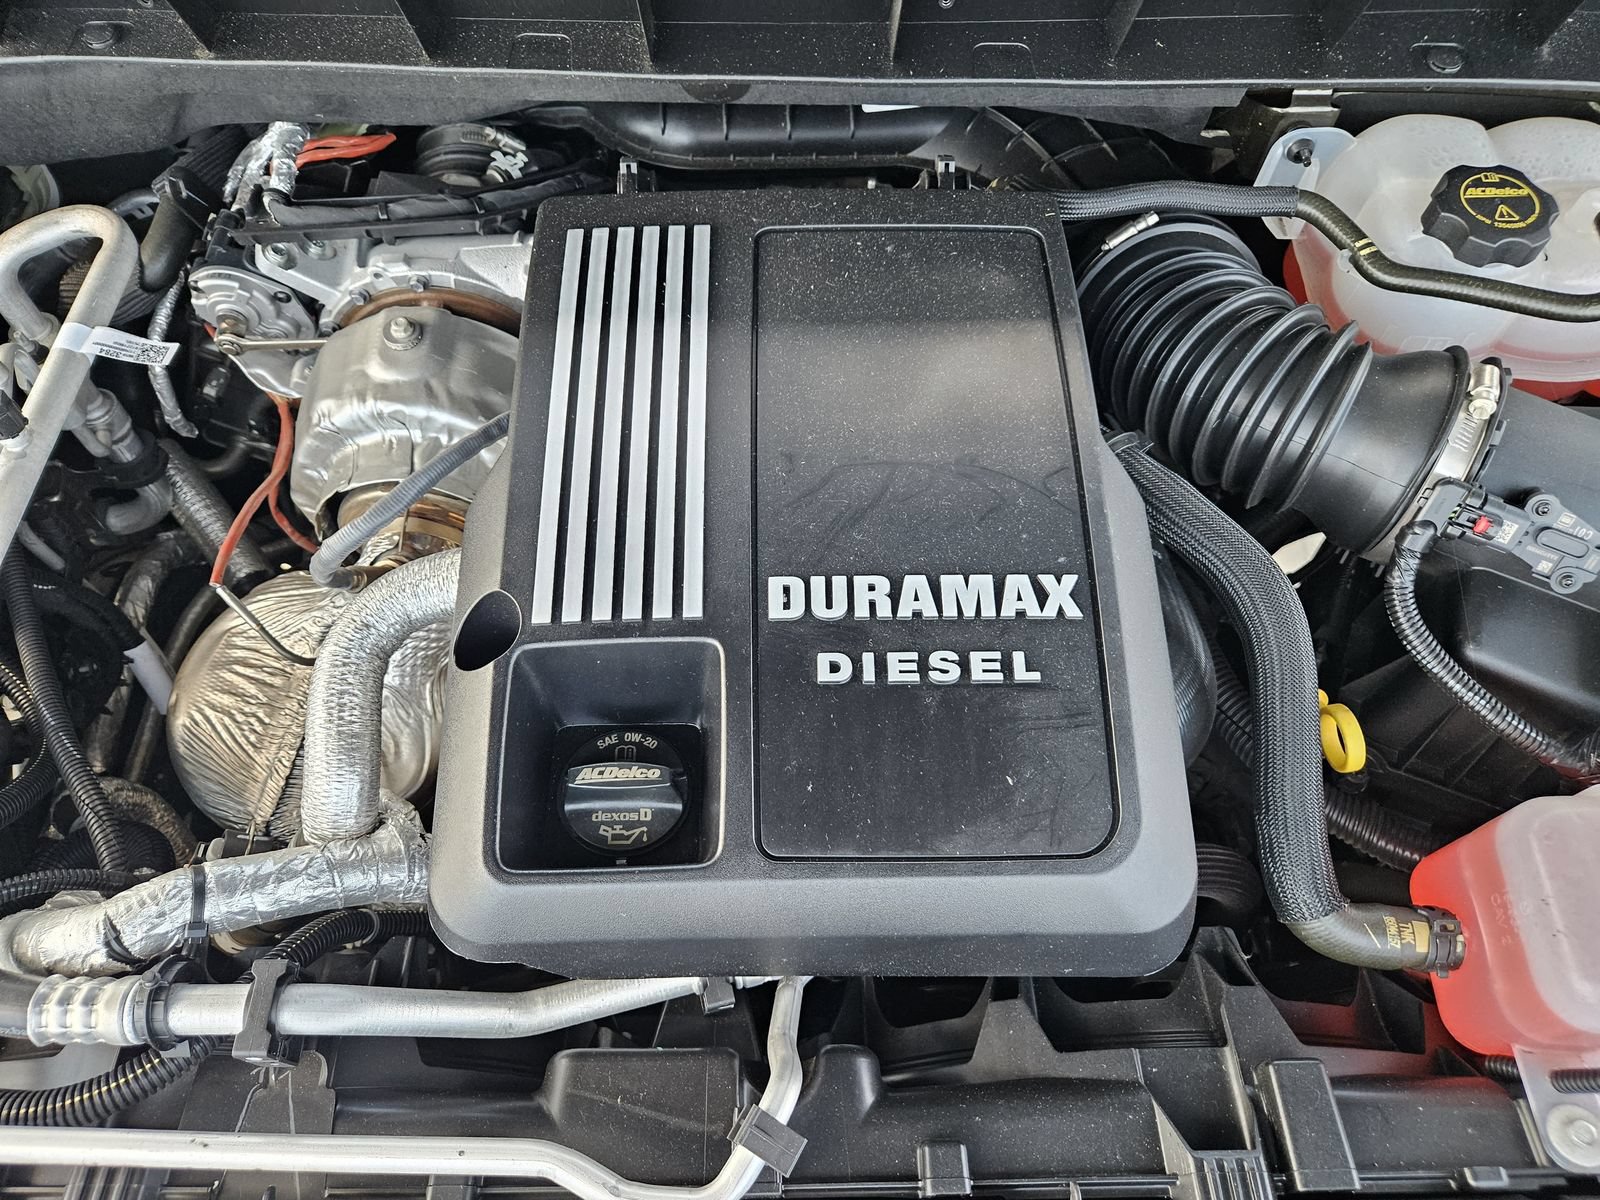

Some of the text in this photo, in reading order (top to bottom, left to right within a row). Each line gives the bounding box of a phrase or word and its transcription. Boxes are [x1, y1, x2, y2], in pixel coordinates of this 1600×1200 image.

[1464, 187, 1530, 197] ACDelco
[99, 347, 122, 359] 3284
[767, 574, 1084, 621] DURAMAX
[816, 650, 1042, 685] DIESEL
[597, 732, 658, 750] SAE 0W-20
[574, 766, 661, 782] ACDelco
[1399, 922, 1416, 945] TNK
